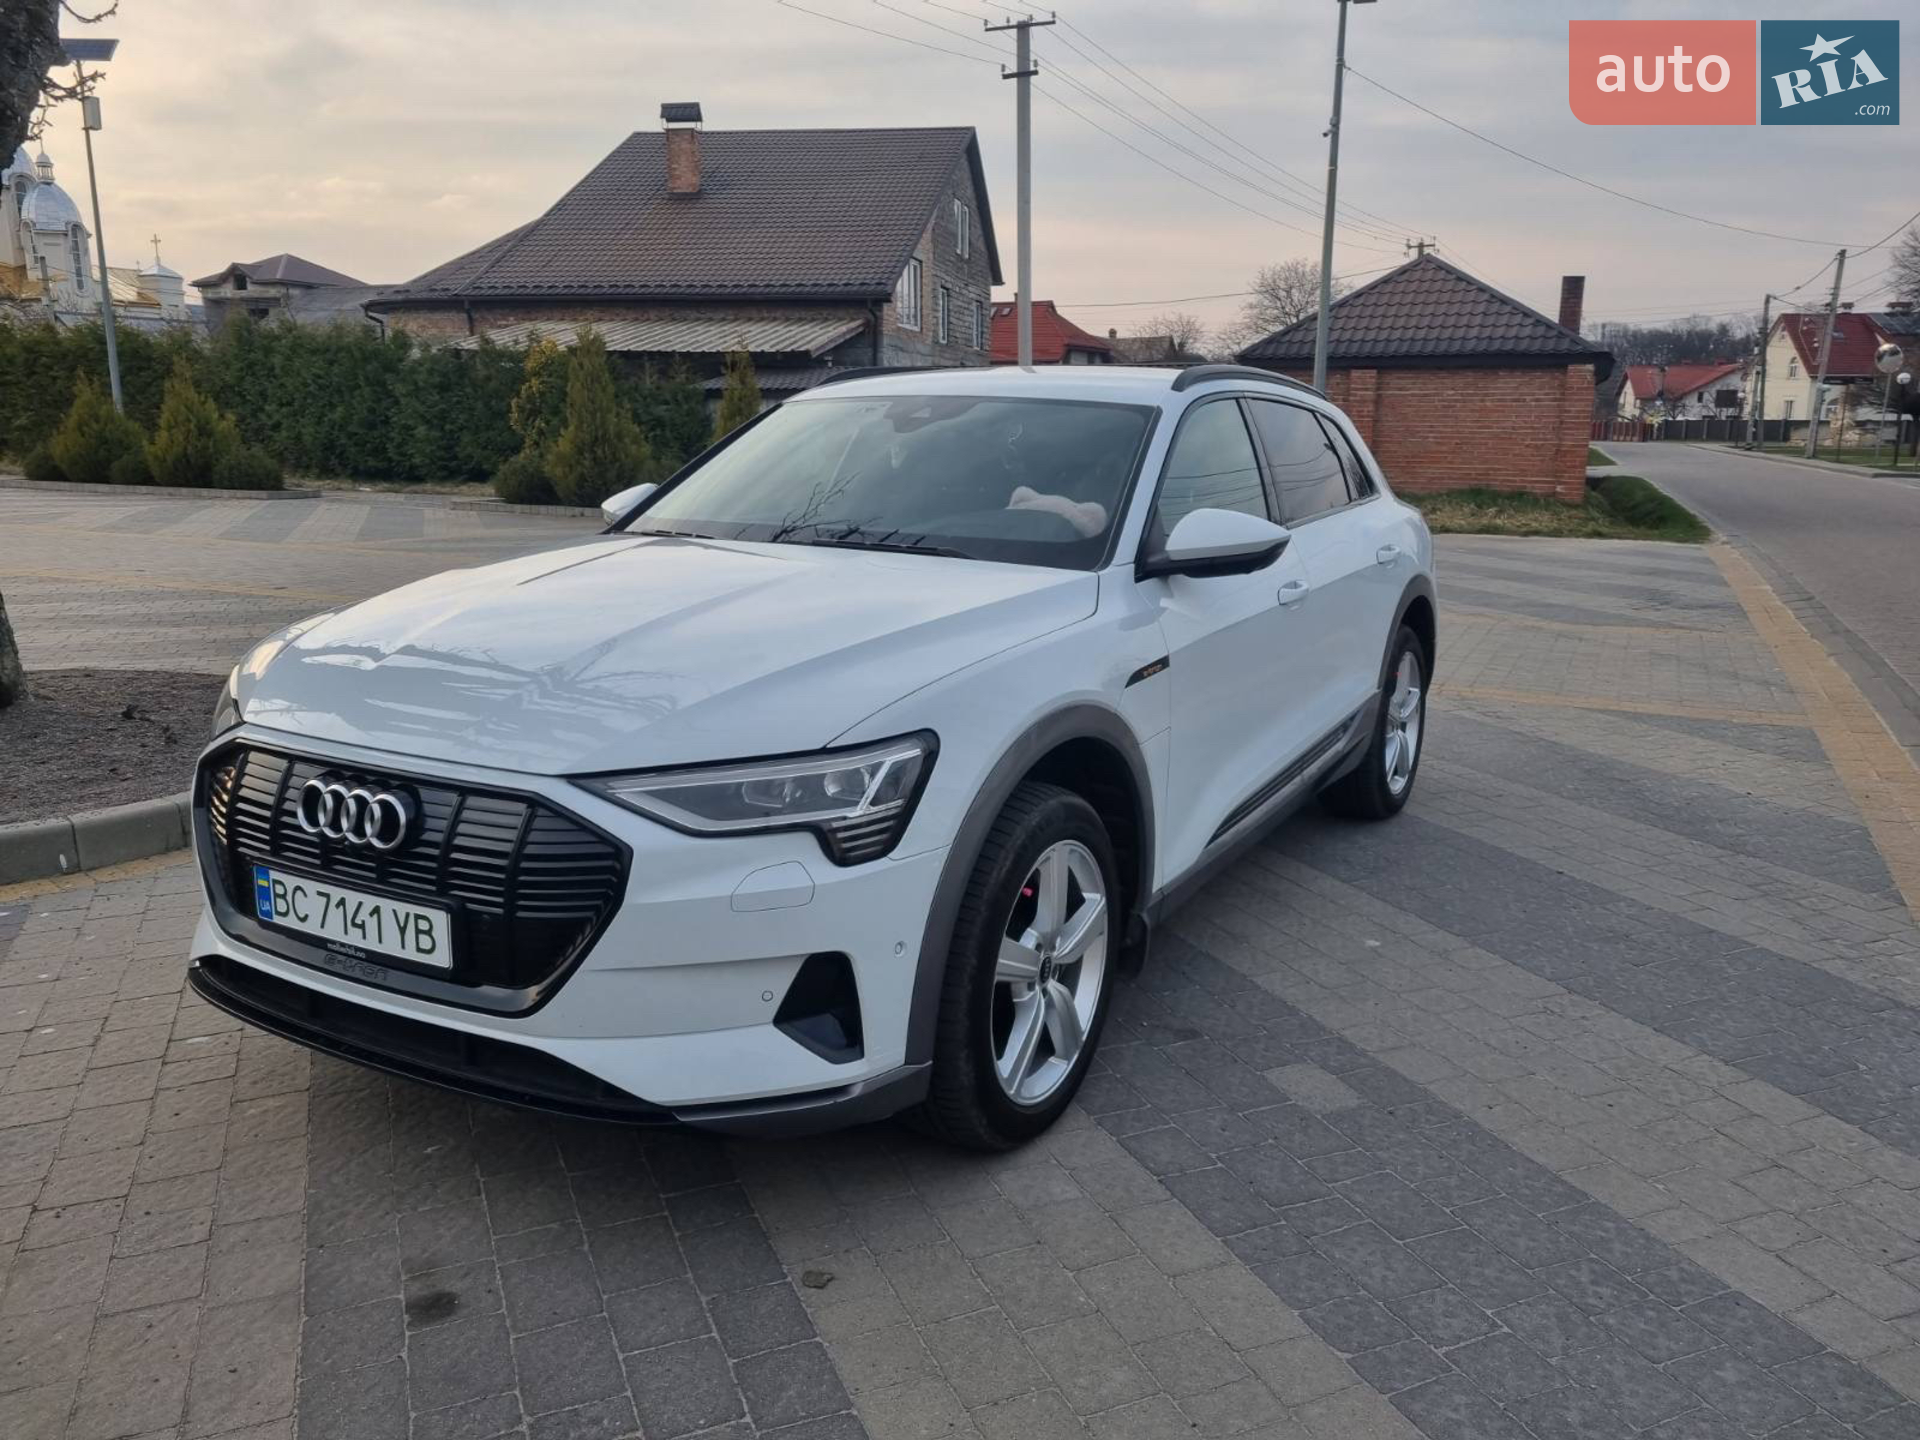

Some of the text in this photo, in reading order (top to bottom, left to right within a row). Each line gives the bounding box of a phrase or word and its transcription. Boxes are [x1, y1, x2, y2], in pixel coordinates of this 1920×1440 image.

[271, 878, 437, 955] BC 7141 YB
